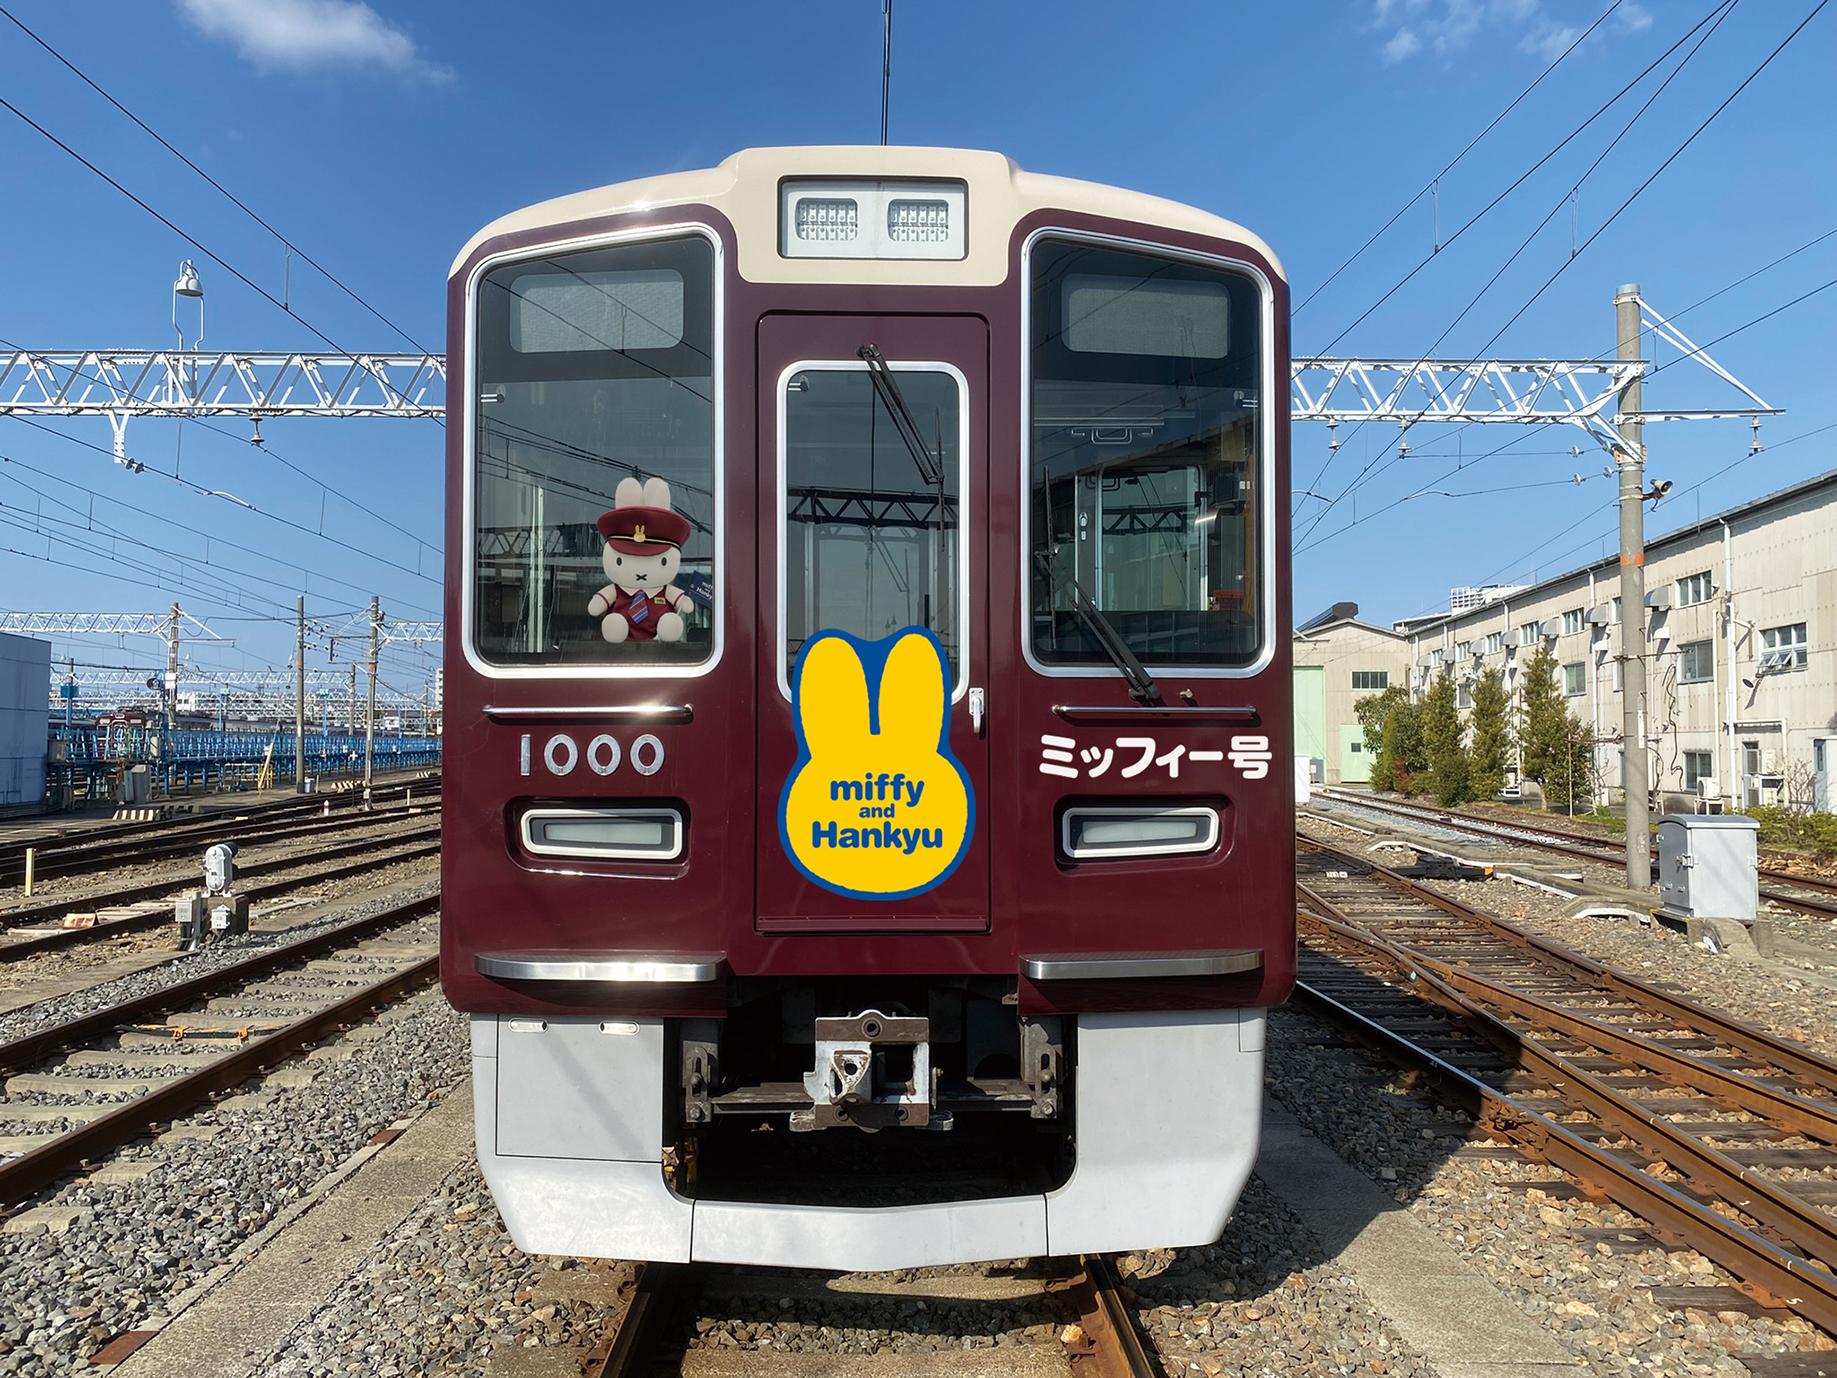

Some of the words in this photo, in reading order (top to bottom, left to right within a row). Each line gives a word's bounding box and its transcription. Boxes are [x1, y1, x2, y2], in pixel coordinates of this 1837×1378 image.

[520, 734, 665, 776] 1000
[1039, 734, 1273, 780] ミッフィー号
[830, 772, 925, 807] miffy
[859, 803, 895, 819] and
[812, 821, 943, 855] Hankyu
